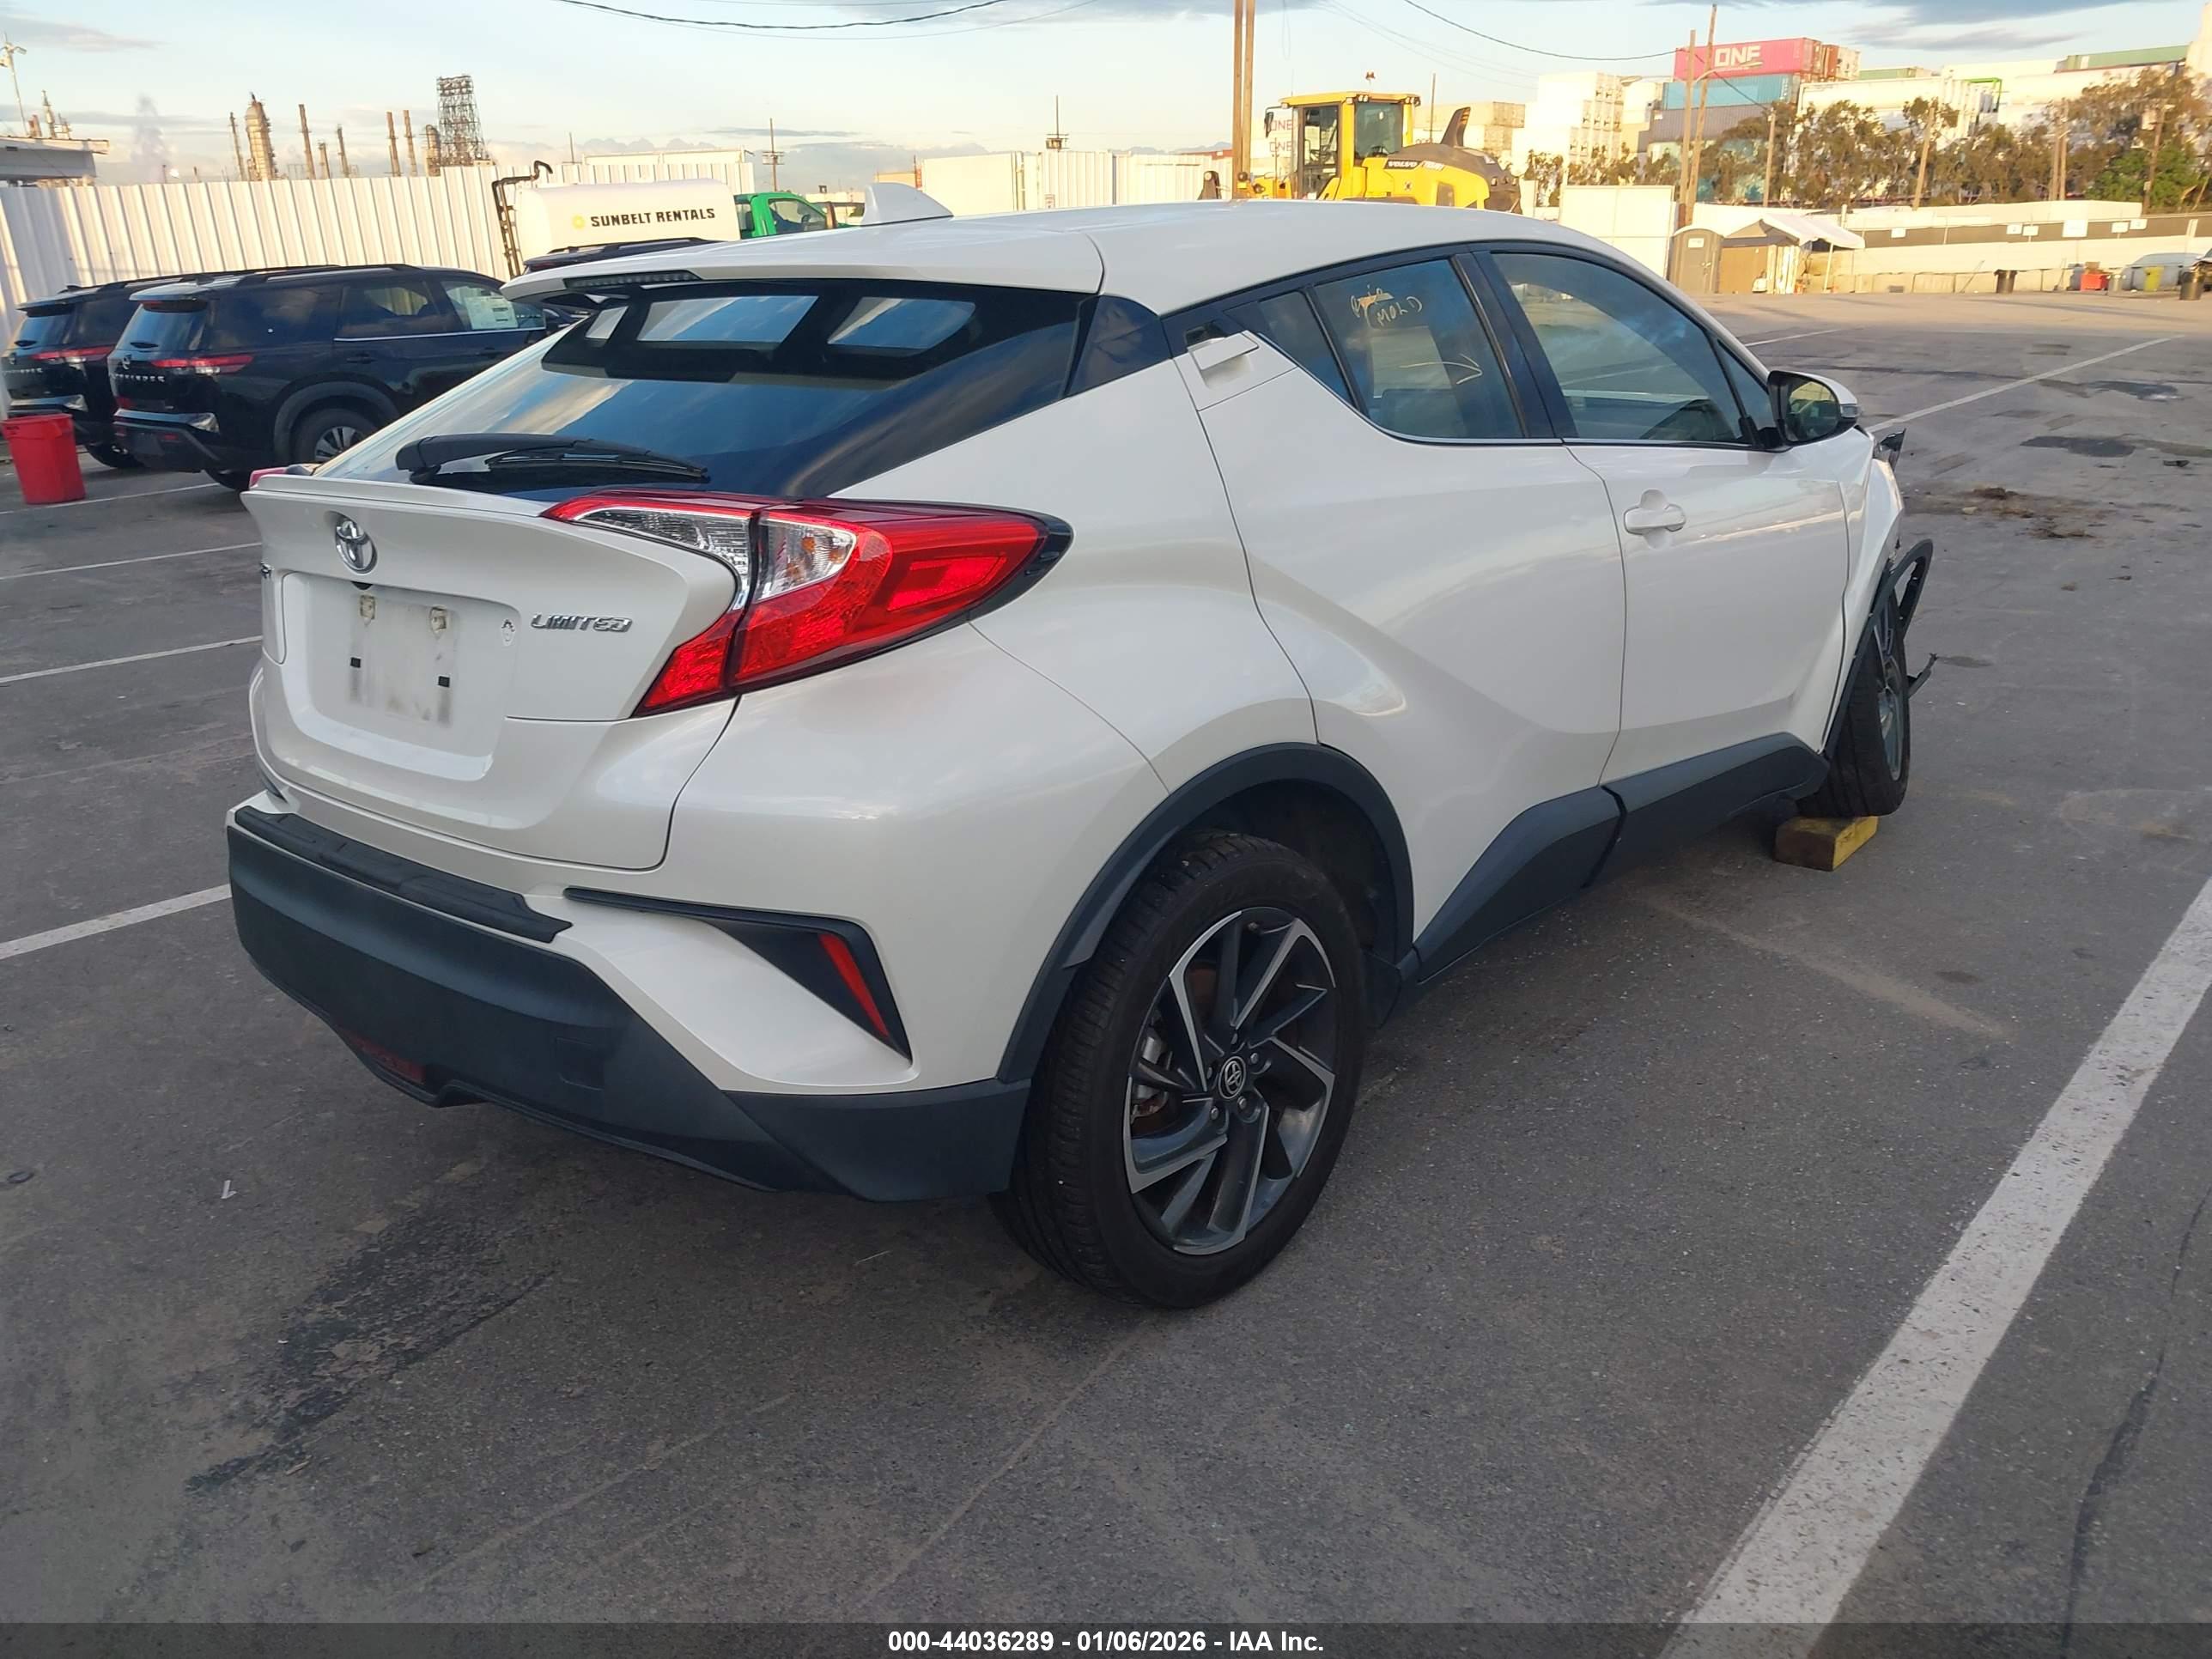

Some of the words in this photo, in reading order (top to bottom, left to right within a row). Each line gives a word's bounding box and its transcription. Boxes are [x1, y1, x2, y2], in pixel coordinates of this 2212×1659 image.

[1715, 46, 1762, 67] ONE
[590, 212, 652, 228] SUNBELT
[656, 208, 715, 223] RENTALS
[530, 613, 633, 633] LIMITED
